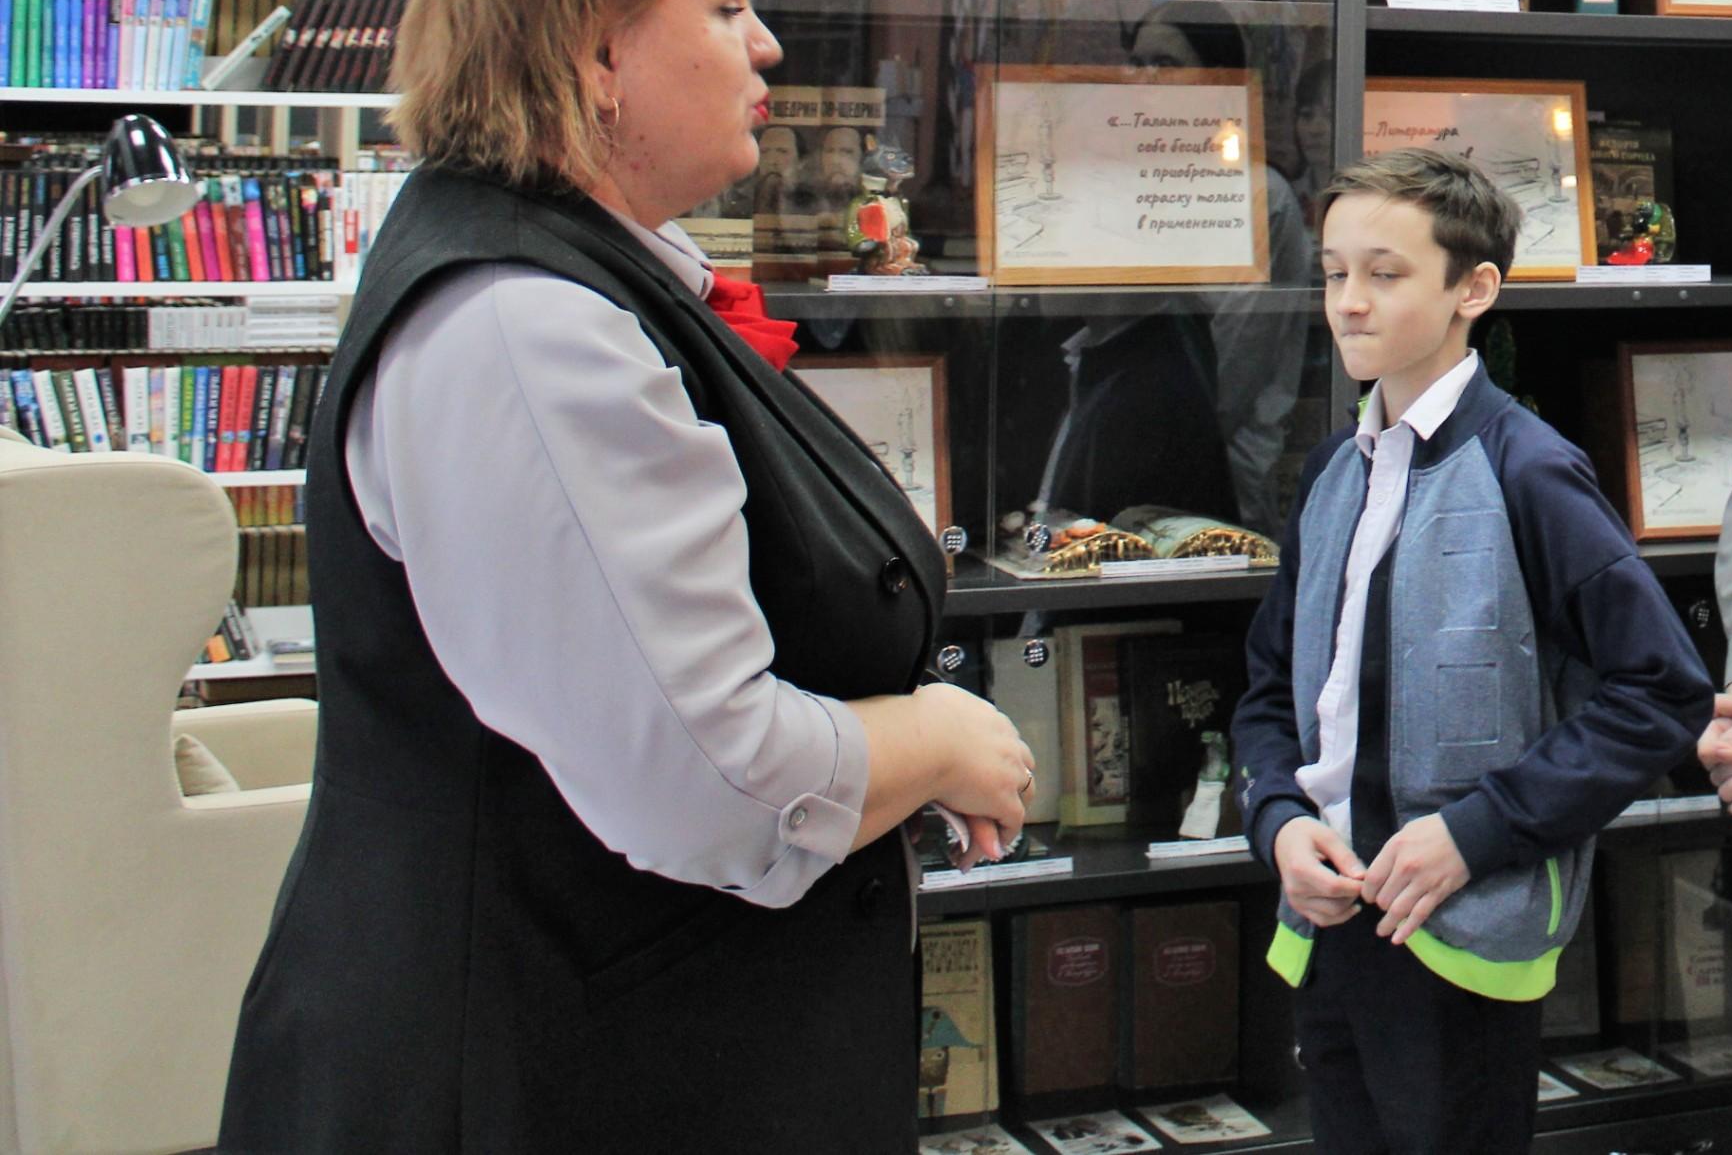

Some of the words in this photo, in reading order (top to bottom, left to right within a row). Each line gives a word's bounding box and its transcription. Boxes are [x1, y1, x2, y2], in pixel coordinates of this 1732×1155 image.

[1137, 138, 1166, 154] себе
[1152, 164, 1244, 182] приобретает
[1136, 193, 1191, 209] окраску
[1197, 192, 1244, 204] только
[1149, 219, 1244, 237] применении»
